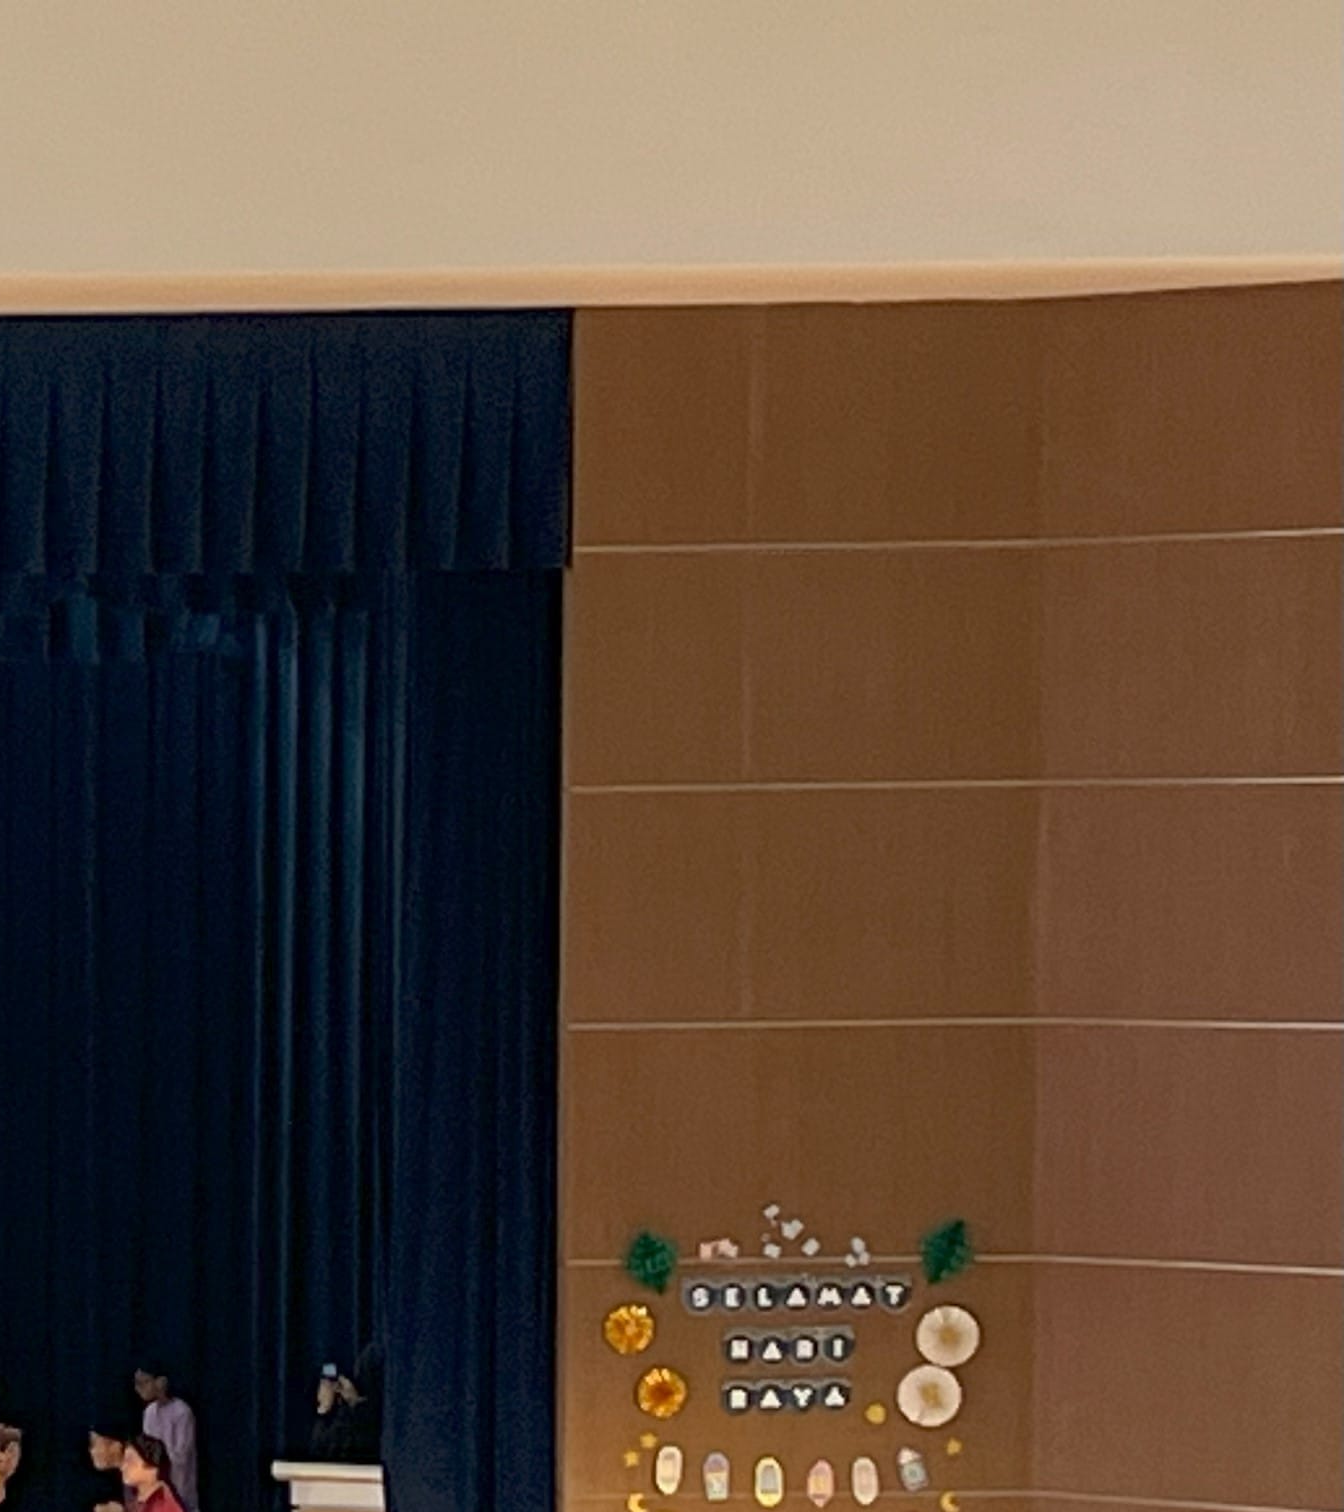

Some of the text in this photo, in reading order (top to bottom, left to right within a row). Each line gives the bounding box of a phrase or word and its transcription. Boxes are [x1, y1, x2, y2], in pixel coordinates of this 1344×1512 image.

[691, 1284, 905, 1308] SELAMAT
[730, 1337, 845, 1360] HARI
[729, 1386, 845, 1409] RAYA
